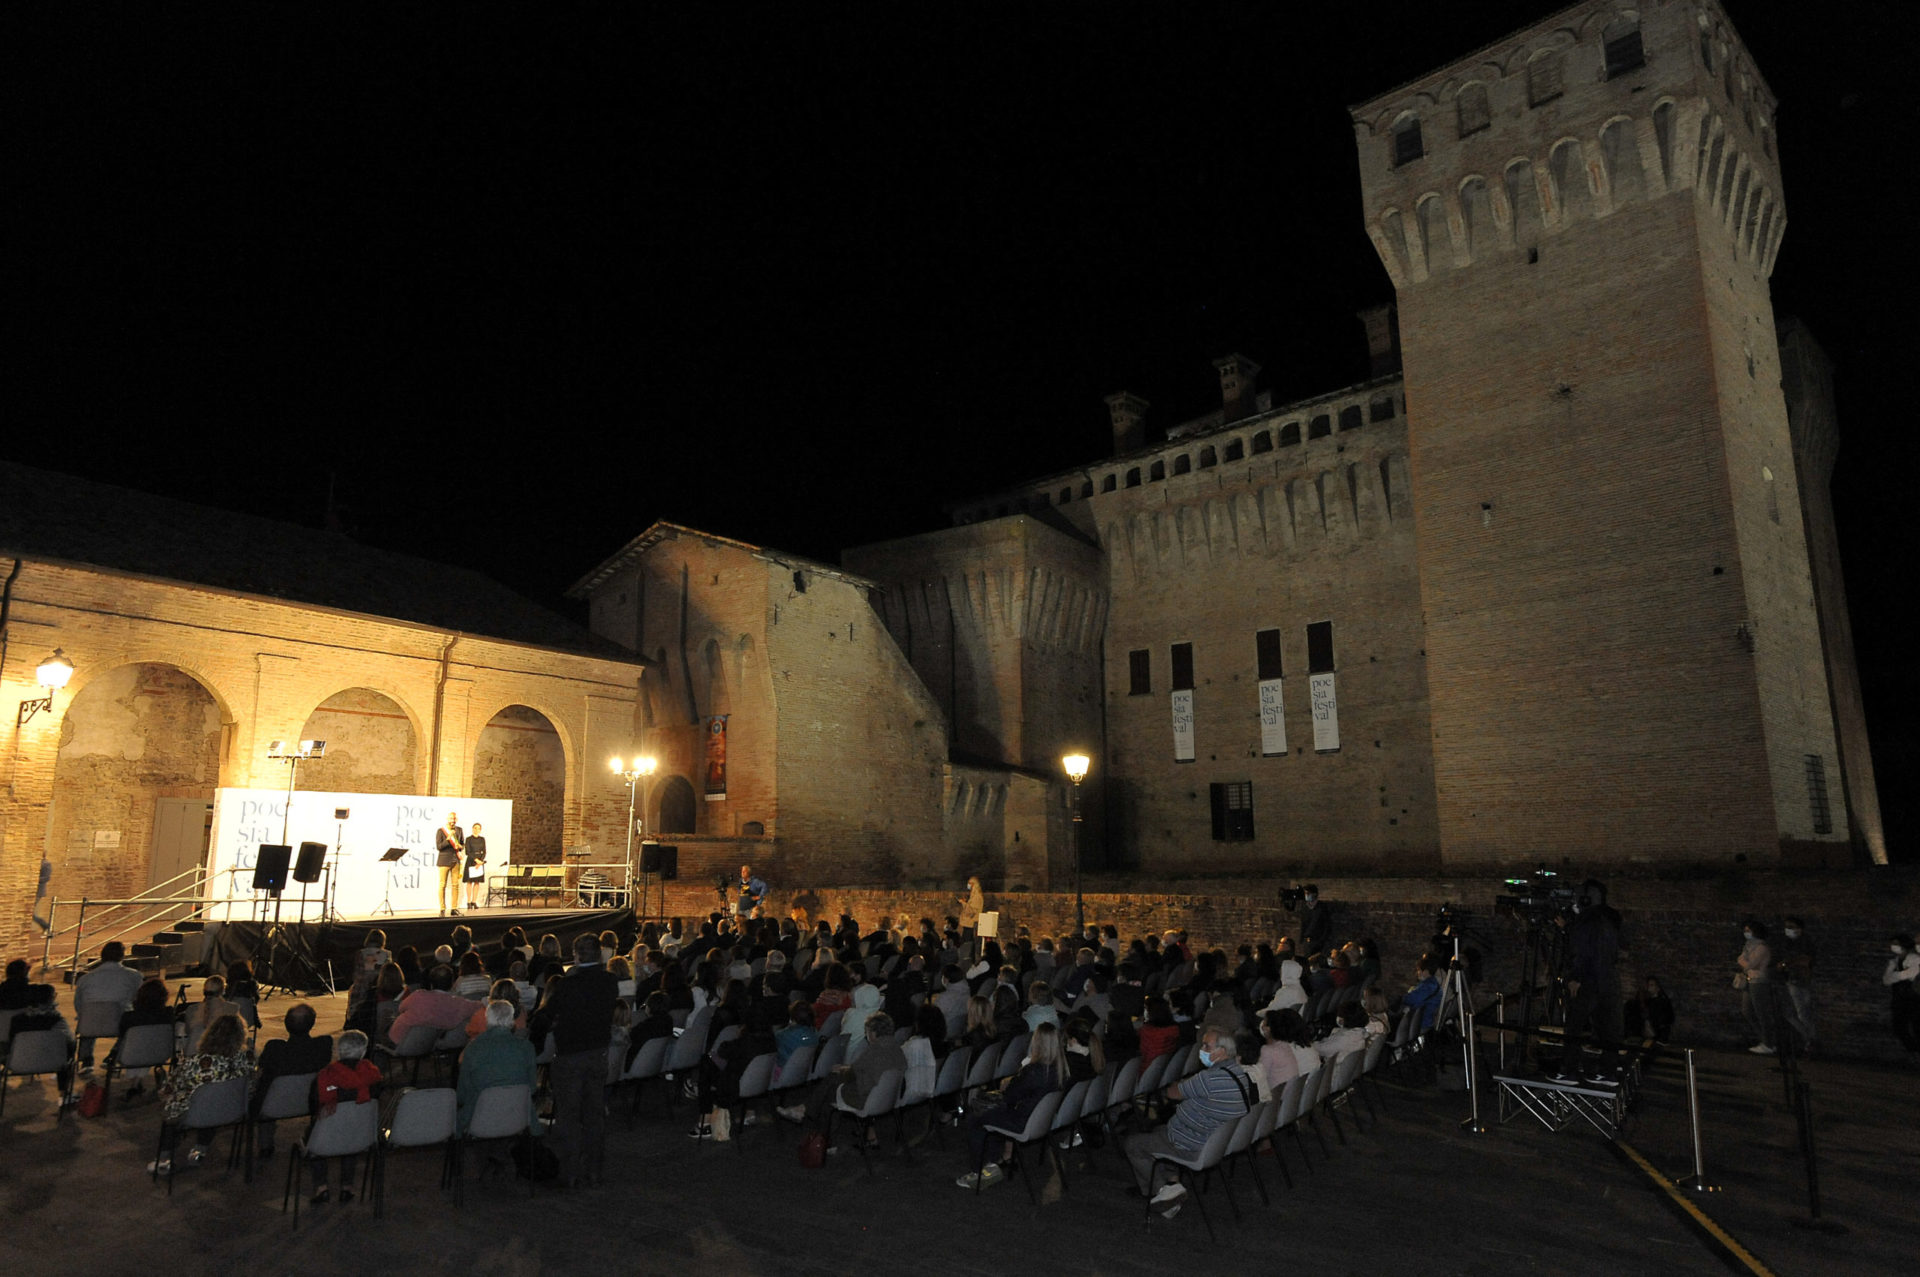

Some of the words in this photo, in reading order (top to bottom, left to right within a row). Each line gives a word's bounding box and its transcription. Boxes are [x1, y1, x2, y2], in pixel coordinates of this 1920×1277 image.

[1262, 694, 1274, 704] sia
[1313, 689, 1327, 698] sia
[1263, 704, 1283, 715] festi
[1314, 698, 1335, 710] festi
[1263, 713, 1276, 725] val
[1314, 709, 1329, 720] val
[397, 806, 434, 826] poe
[237, 820, 270, 842] sia
[396, 824, 421, 843] sia
[393, 868, 420, 888] val
